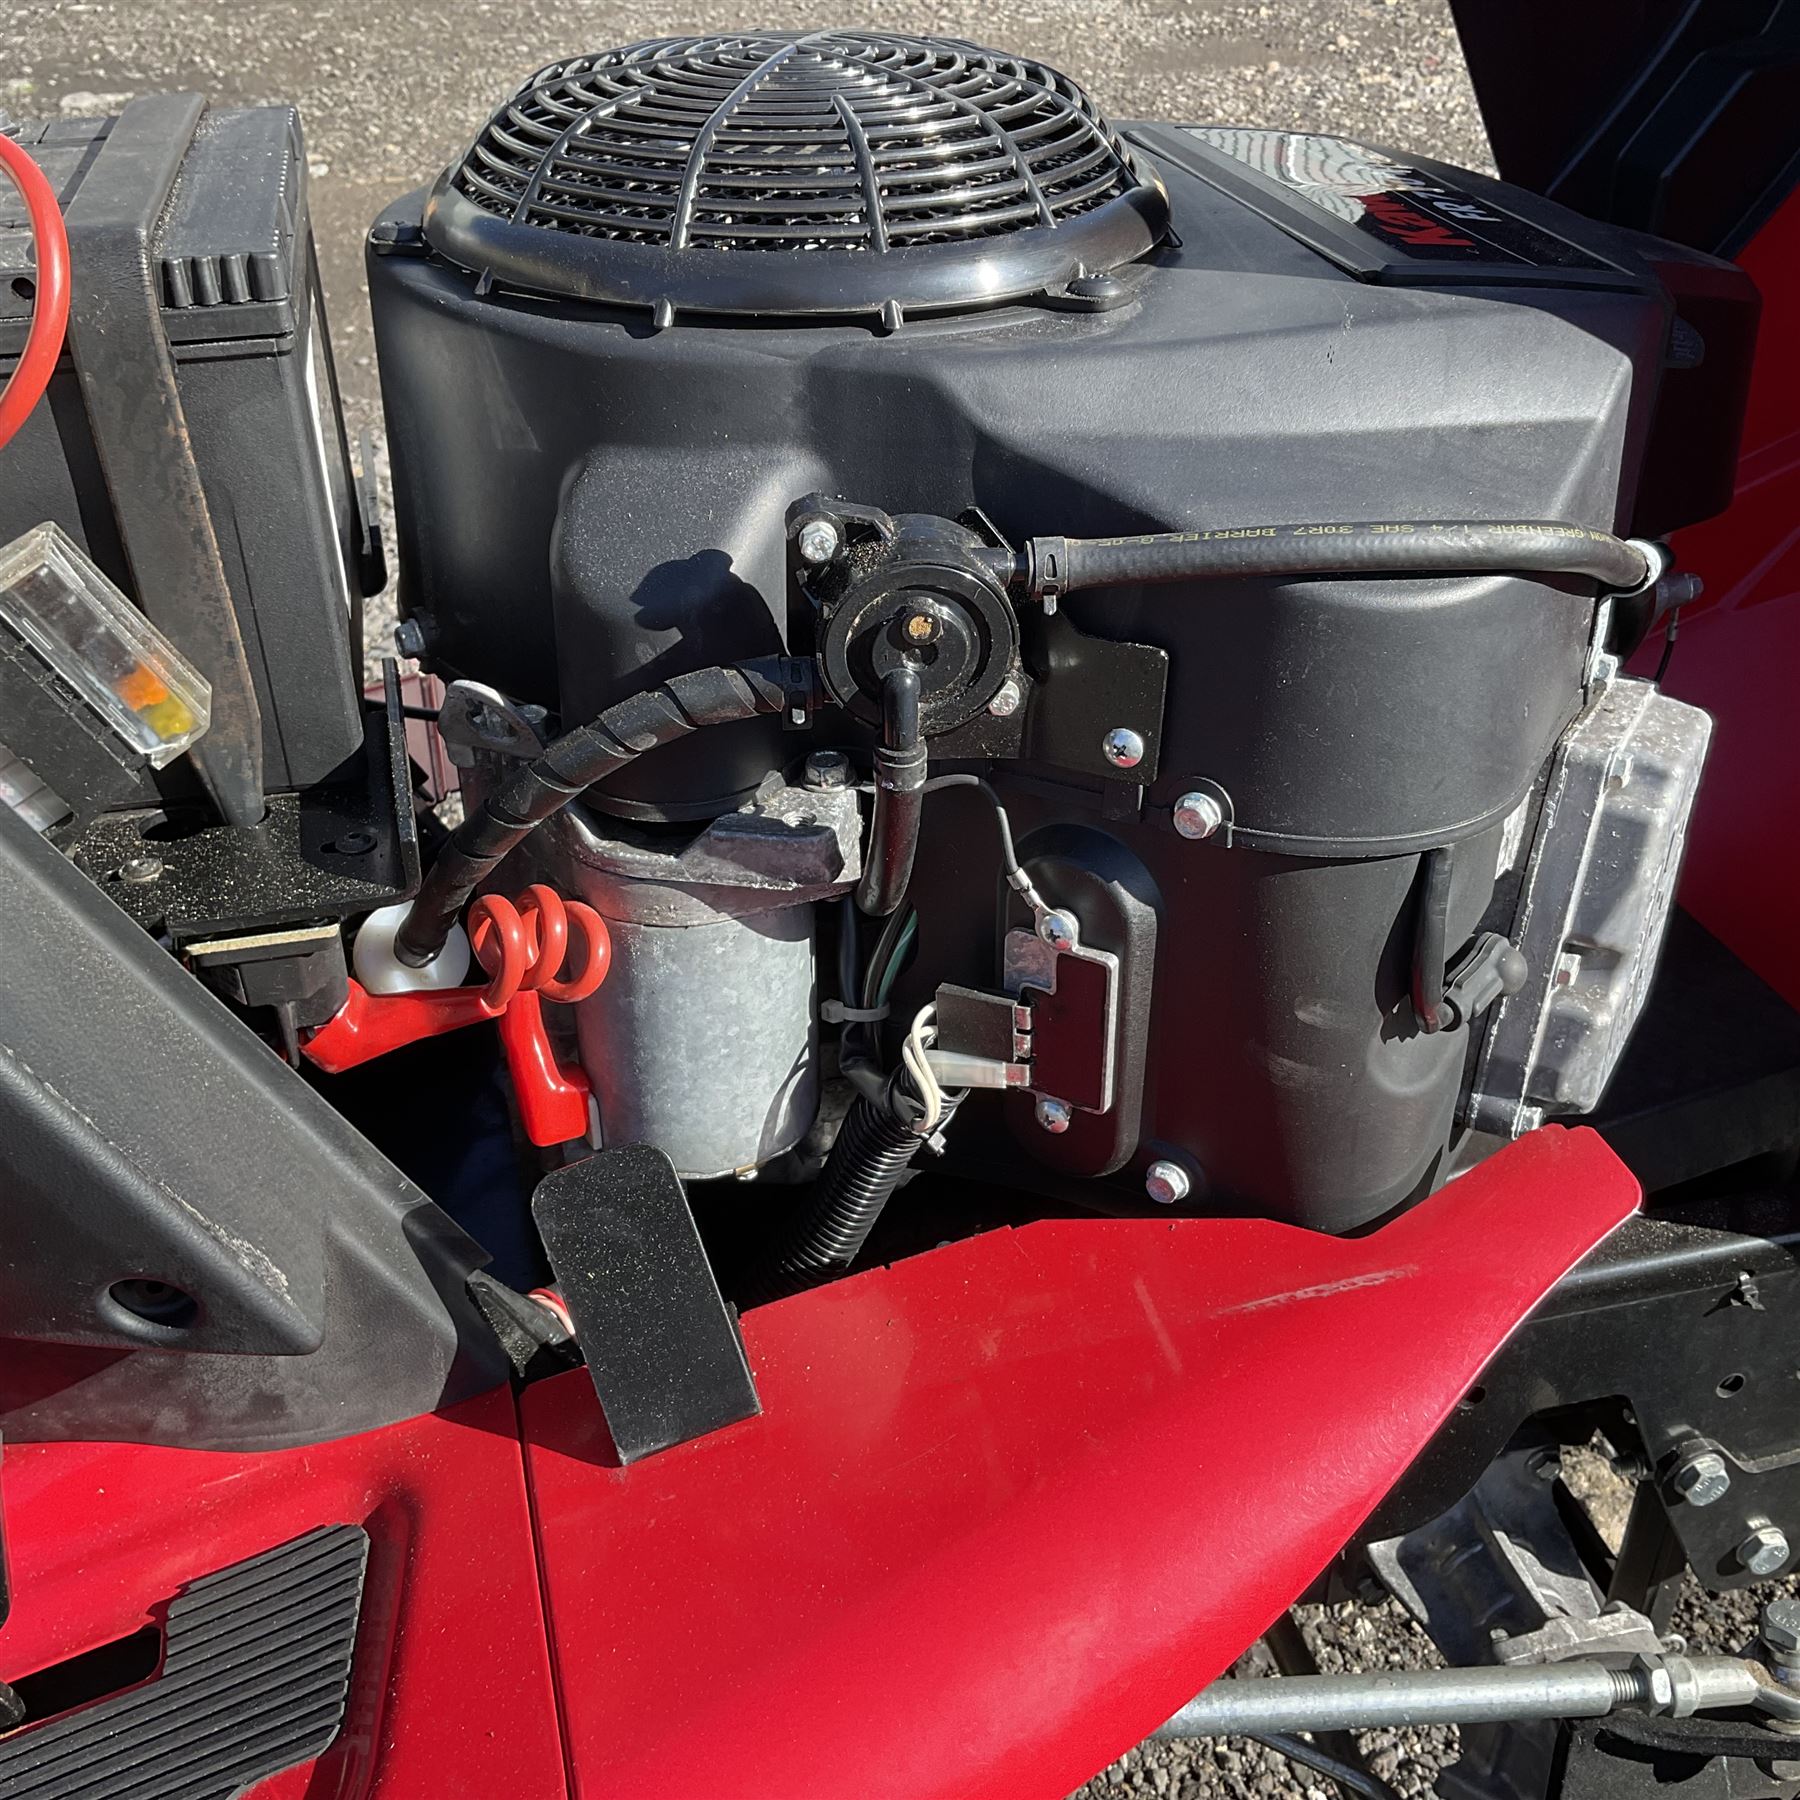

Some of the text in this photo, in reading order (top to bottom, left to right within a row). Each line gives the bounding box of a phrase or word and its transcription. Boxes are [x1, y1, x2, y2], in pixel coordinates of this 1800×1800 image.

[1169, 527, 1277, 543] BARRIER
[1293, 525, 1354, 535] 30R7
[1369, 524, 1415, 535] SAE
[1487, 524, 1584, 538] GREENBAR
